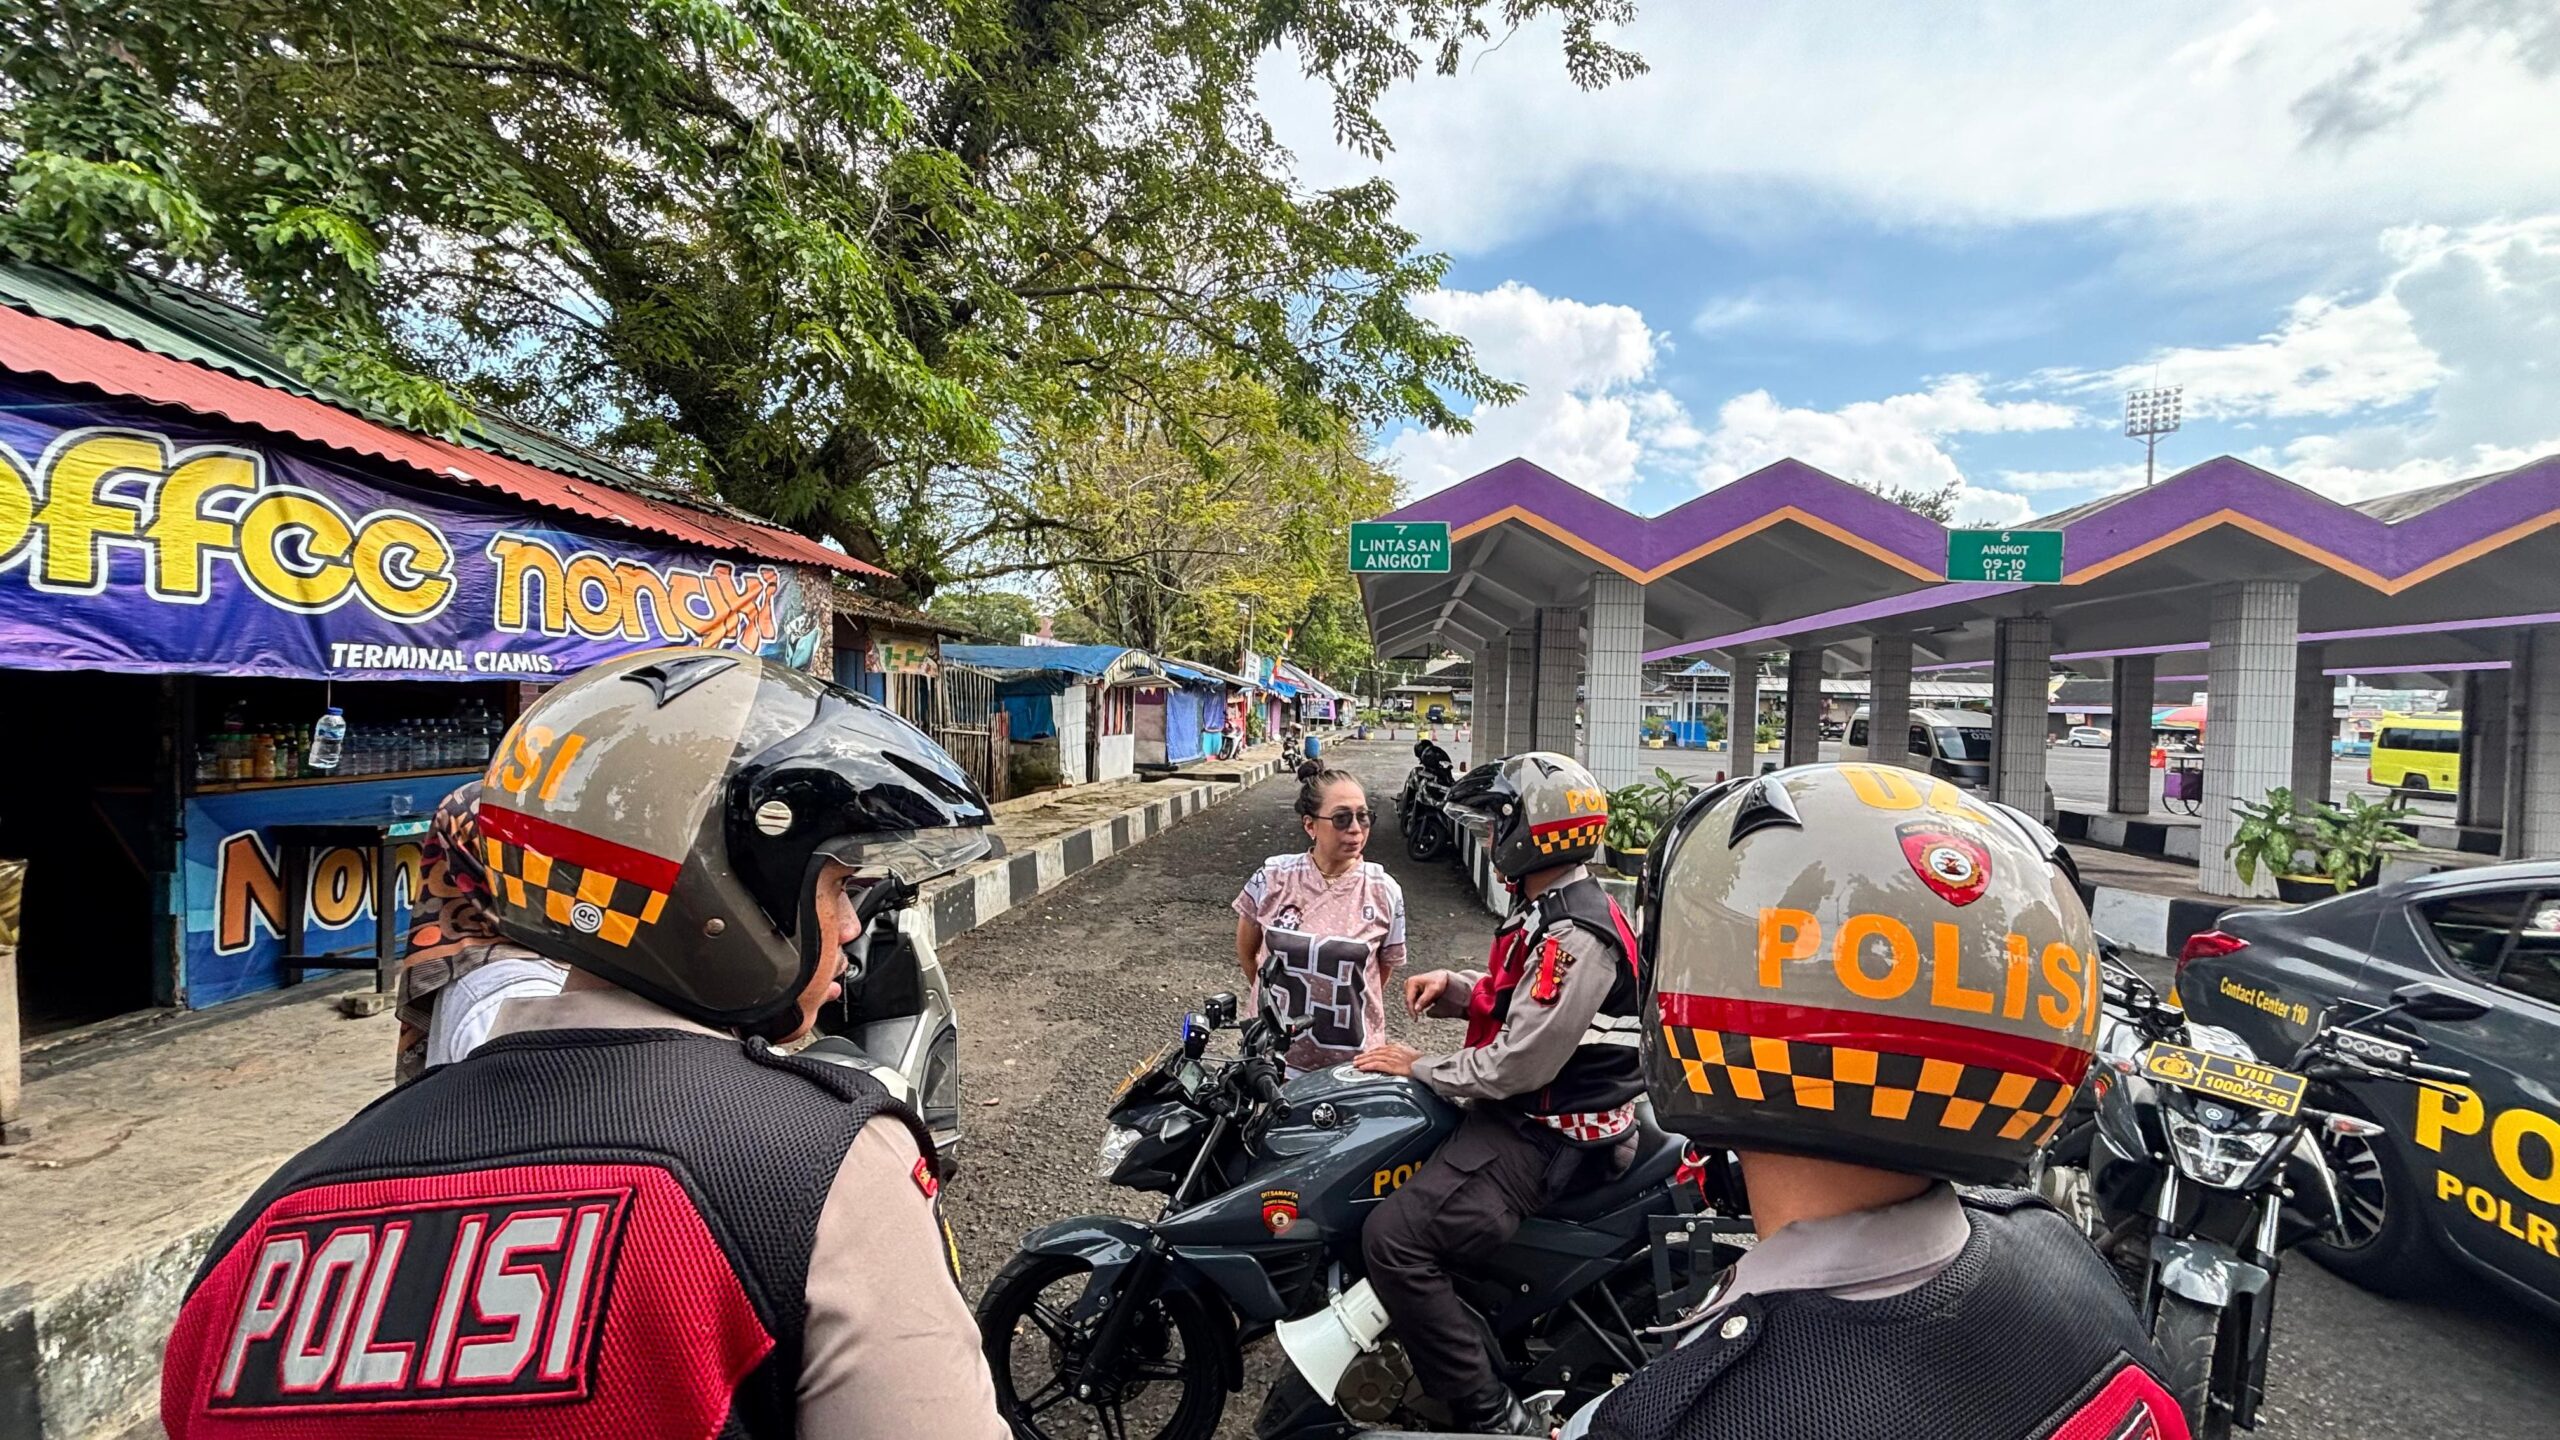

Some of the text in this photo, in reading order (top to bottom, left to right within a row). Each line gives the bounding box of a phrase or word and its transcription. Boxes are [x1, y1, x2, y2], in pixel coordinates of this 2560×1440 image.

[1394, 525, 1408, 535] 7
[2001, 531, 2010, 542] 6
[1359, 539, 1440, 552] LINTASAN
[1981, 544, 2030, 555] ANGKOT
[1365, 554, 1432, 568] ANGKOT
[1982, 558, 2026, 570] 09-10
[1985, 569, 2023, 580] 11-12
[331, 643, 553, 673] TERMINAL CIAMIS
[1758, 907, 2097, 1036] POLISI
[2220, 976, 2309, 1026] Contact Center 110
[2234, 1064, 2275, 1084] VIII
[215, 1203, 610, 1398] POLISI
